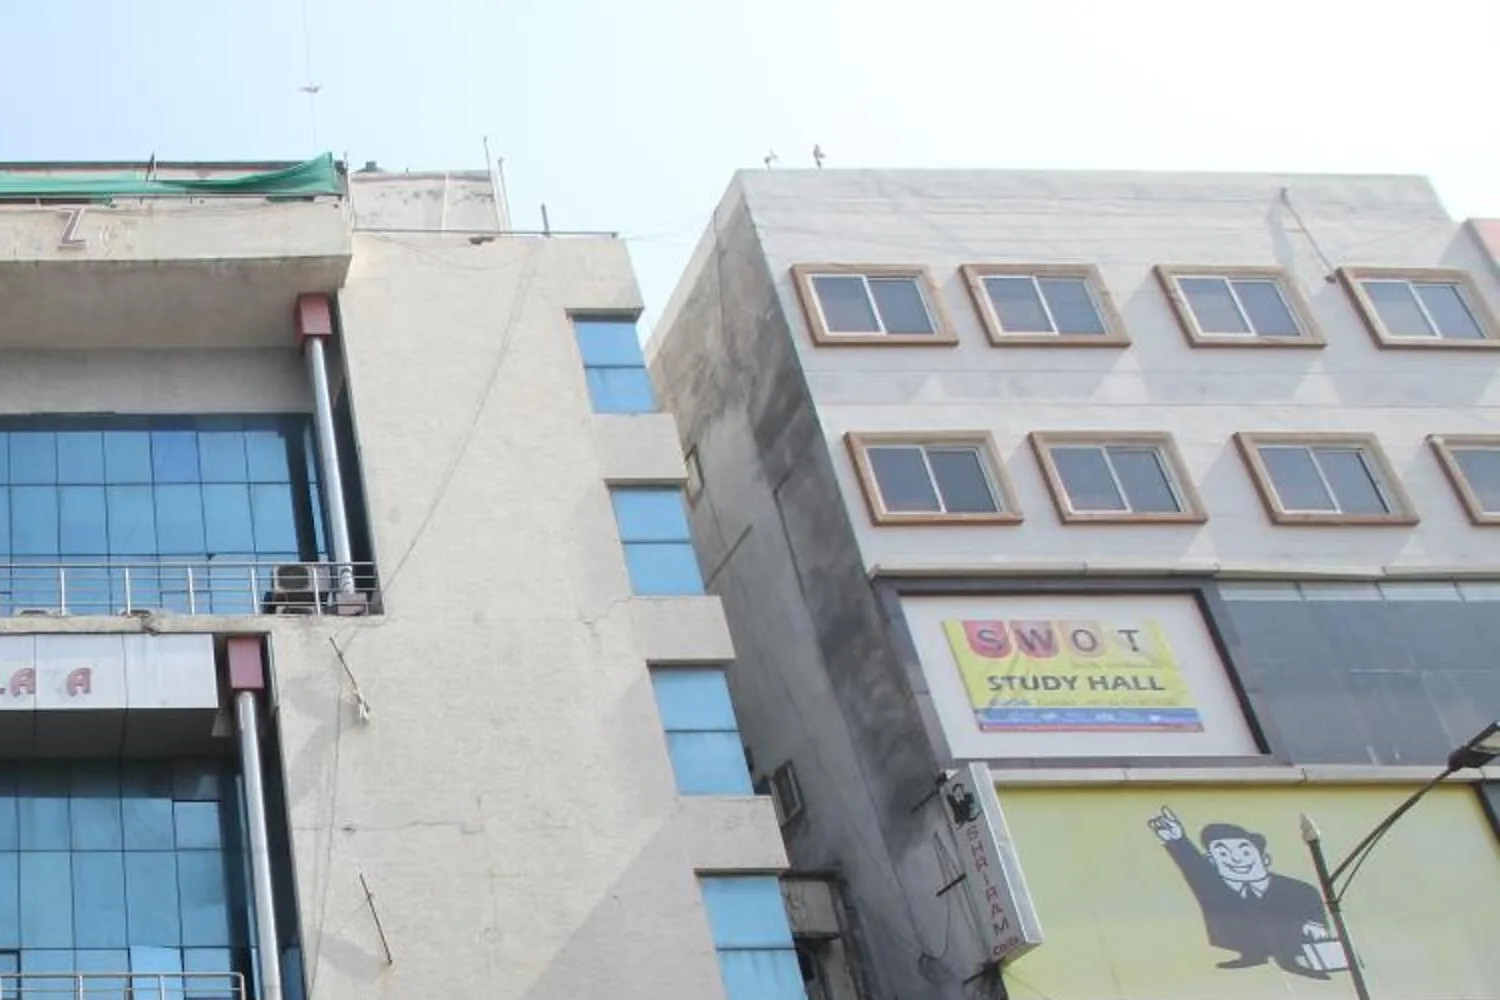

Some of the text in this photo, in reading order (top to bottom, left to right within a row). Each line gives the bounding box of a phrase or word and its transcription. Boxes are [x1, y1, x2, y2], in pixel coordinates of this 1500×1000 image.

[976, 628, 1141, 653] SWOT
[987, 674, 1167, 692] STUDY HALL
